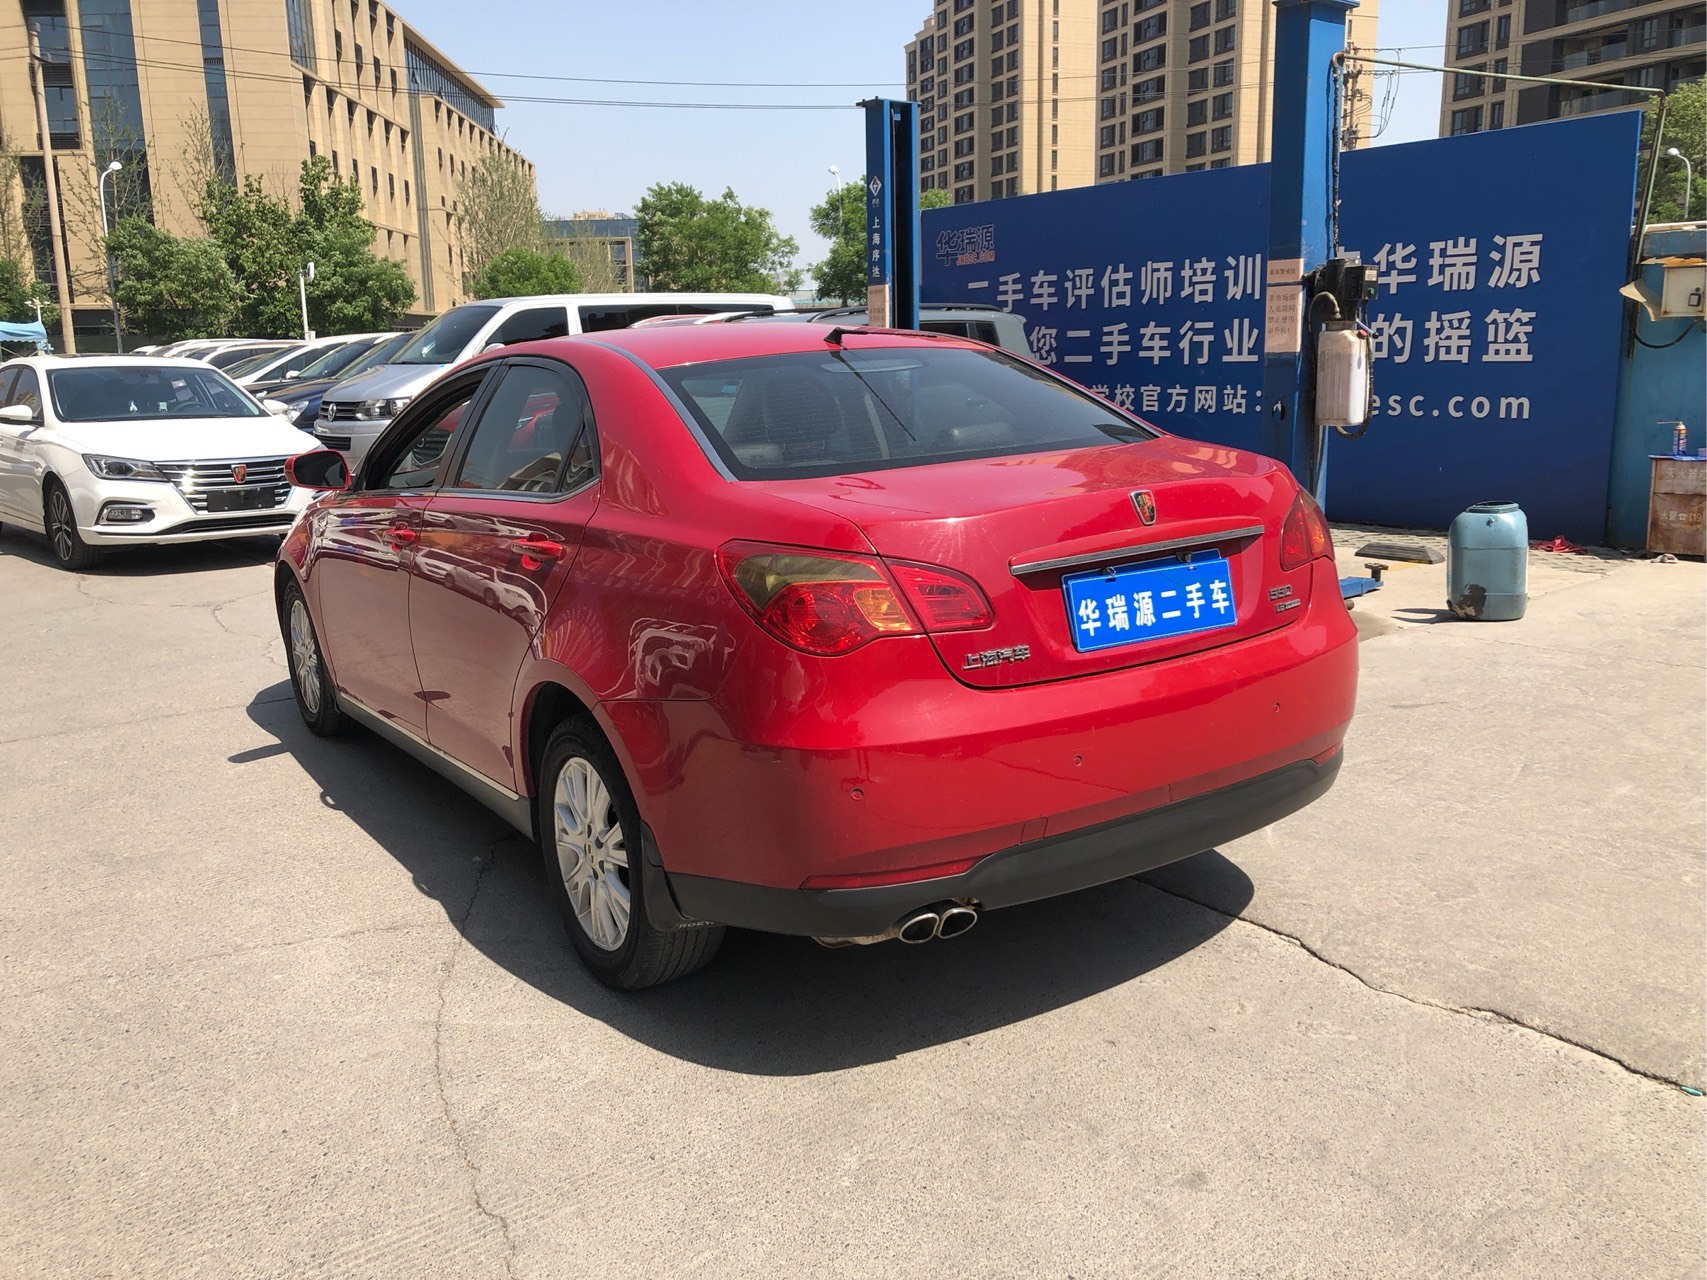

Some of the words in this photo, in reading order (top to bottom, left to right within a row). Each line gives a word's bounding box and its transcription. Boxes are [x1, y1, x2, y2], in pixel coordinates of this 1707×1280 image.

[872, 216, 881, 278] 上海序达
[936, 224, 995, 266] 华瑞源
[1337, 233, 1543, 294] 华瑞源
[1029, 318, 1259, 366] 您二手车行业
[1371, 308, 1537, 363] 的摇篮
[1268, 316, 1296, 324] 禁止使用
[1078, 579, 1231, 637] 华瑞源二手车
[962, 645, 1031, 670] 上海汽车
